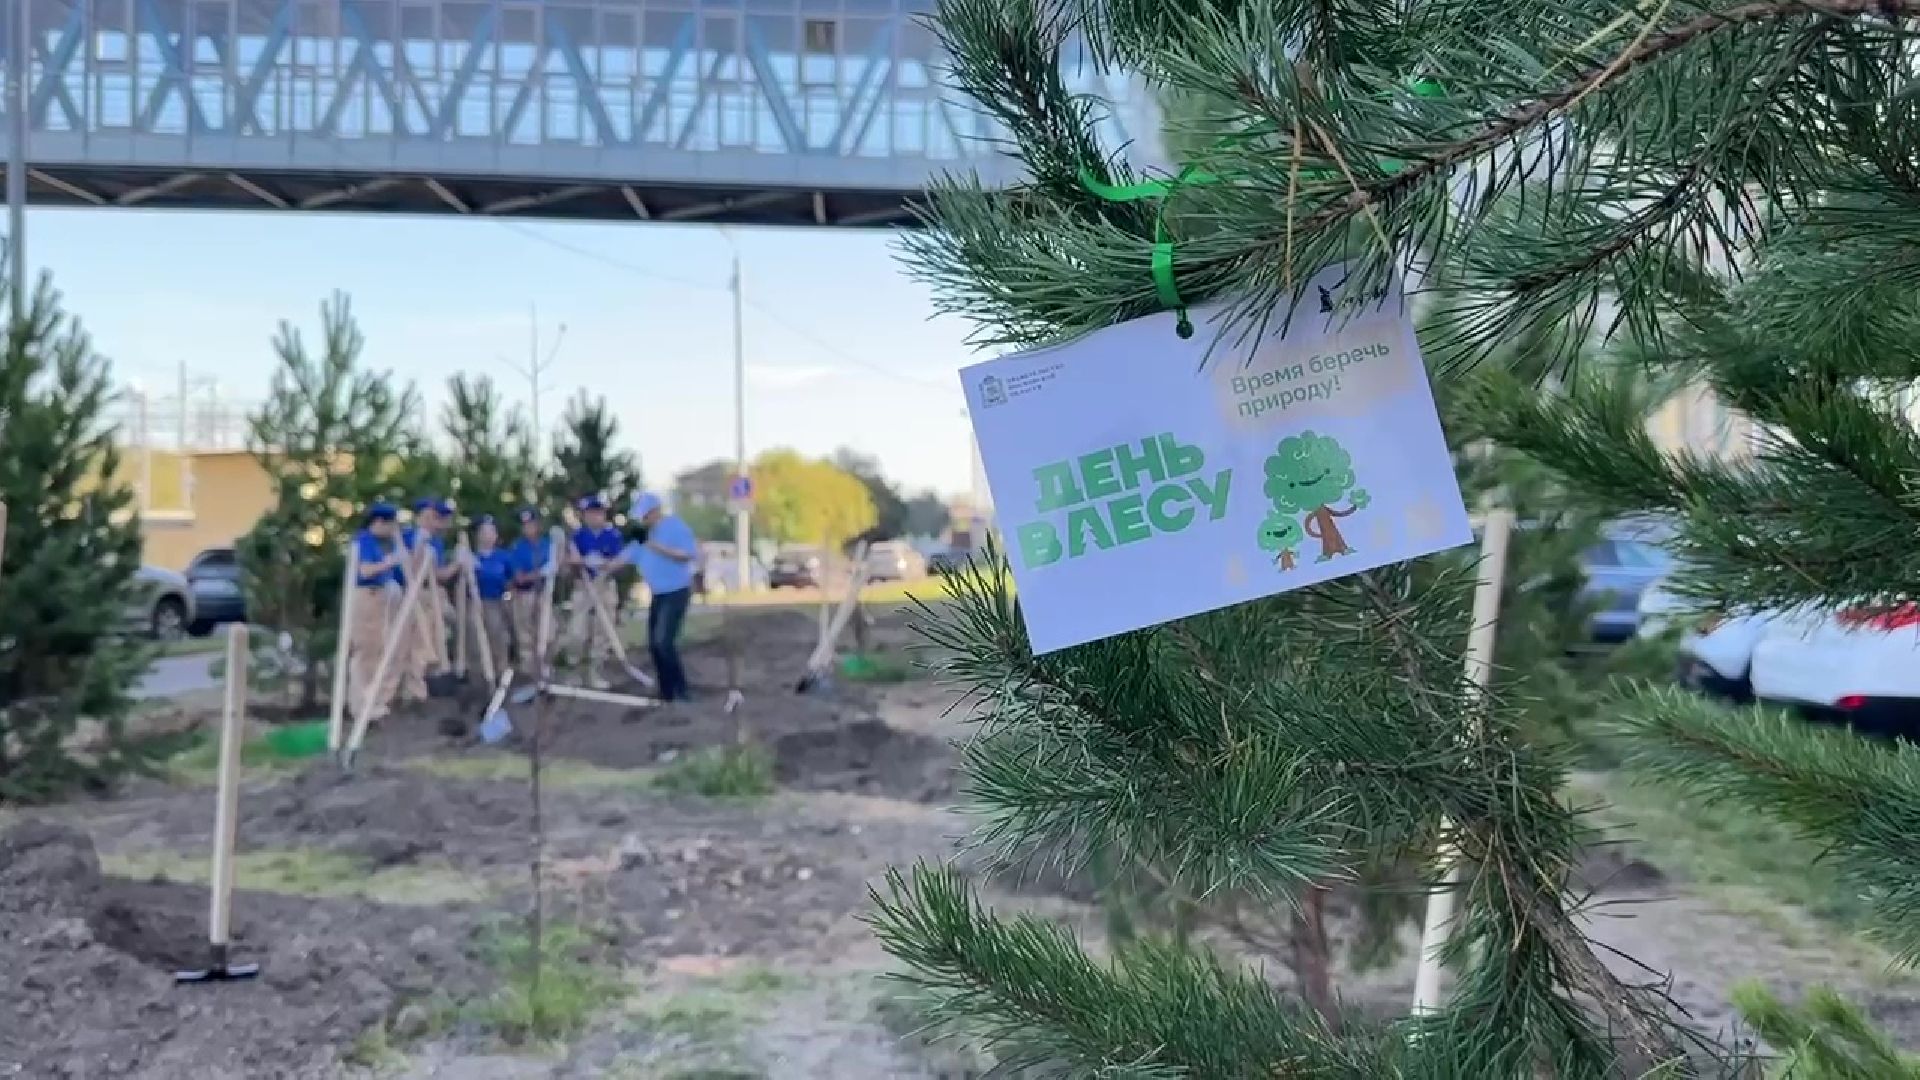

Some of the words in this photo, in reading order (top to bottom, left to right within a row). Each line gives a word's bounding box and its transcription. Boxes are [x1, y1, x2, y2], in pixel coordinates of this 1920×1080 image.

[1231, 363, 1305, 397] Время
[1308, 342, 1390, 373] беречь
[1237, 374, 1342, 418] природу!
[1032, 431, 1205, 514] ДЕНЬ
